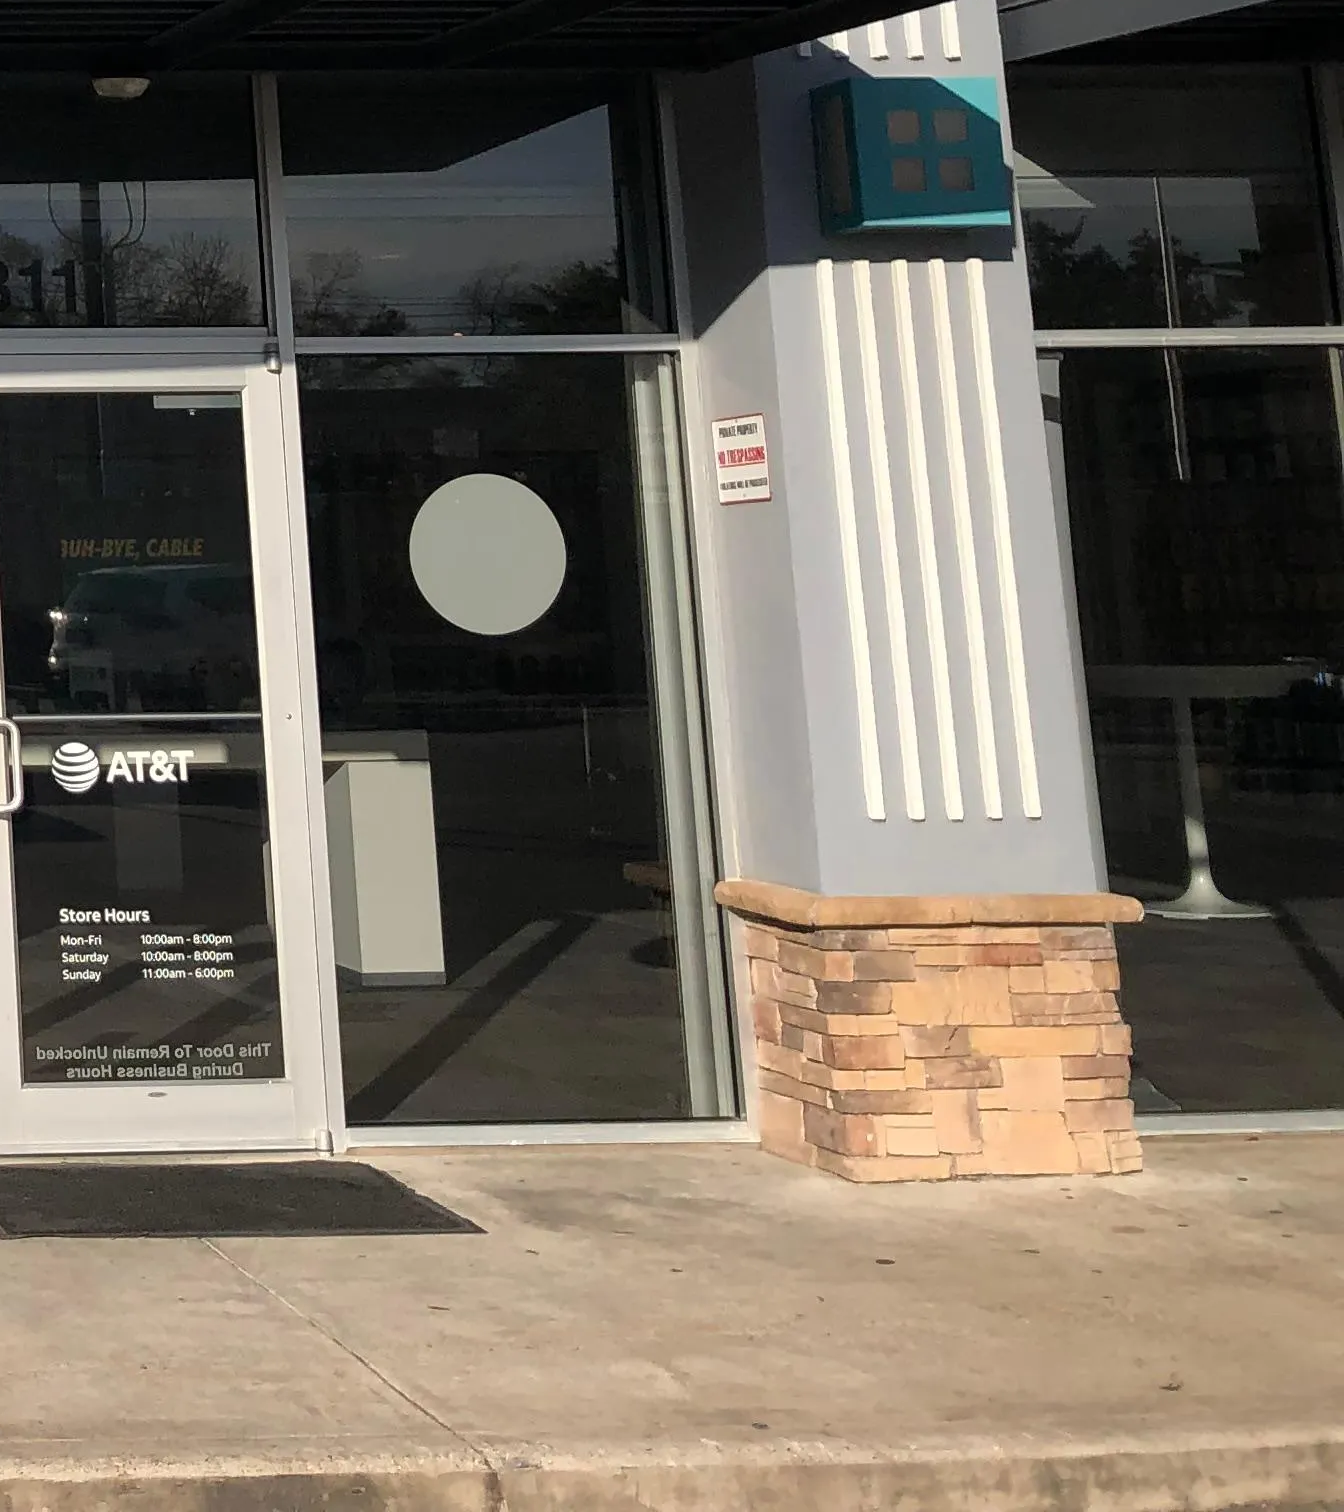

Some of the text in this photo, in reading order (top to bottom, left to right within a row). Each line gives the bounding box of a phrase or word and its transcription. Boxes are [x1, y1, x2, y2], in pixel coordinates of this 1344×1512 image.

[146, 538, 205, 557] CABLE
[106, 749, 194, 784] AT&T
[59, 907, 151, 923] Store Hours
[60, 934, 102, 946] Mon-Fri
[140, 934, 184, 945] 10:00am
[192, 933, 233, 947] 8:00pm
[61, 951, 109, 965] Saturday
[141, 951, 185, 962] 10:00am
[193, 950, 234, 963] 8:00pm
[62, 969, 102, 982] Sunday
[141, 968, 186, 979] 11:00am
[195, 967, 235, 981] 6:00pm
